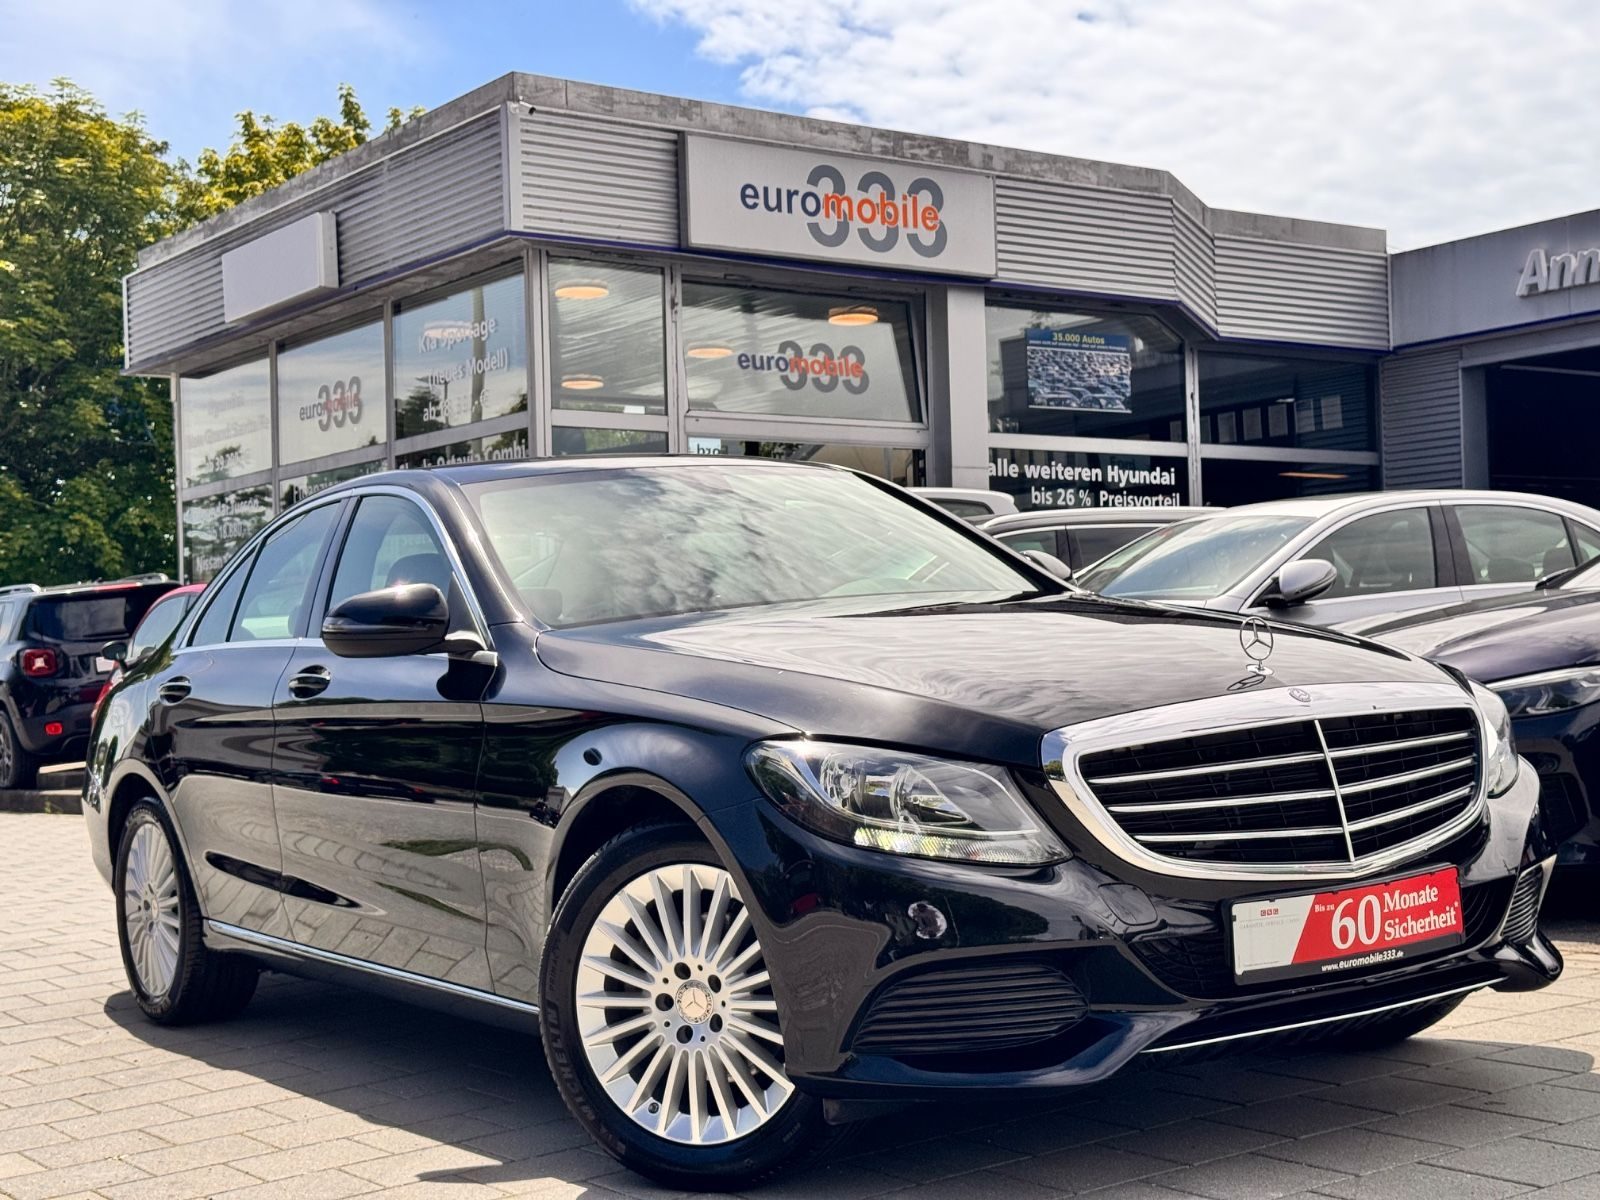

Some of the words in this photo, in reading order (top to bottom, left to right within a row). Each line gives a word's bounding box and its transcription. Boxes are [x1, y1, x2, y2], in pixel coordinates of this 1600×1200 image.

[740, 183, 939, 231] euromobile
[807, 165, 948, 258] 333
[1515, 248, 1600, 296] Ann
[1082, 335, 1104, 345] Autos
[466, 348, 509, 375] Modell)
[738, 352, 864, 377] euromobile
[778, 340, 870, 395] 333
[318, 376, 362, 432] 333
[423, 402, 436, 421] ab
[988, 458, 1019, 478] alle
[1024, 461, 1102, 482] weiteren
[1107, 465, 1175, 487] Hyundai
[1031, 486, 1053, 505] bis
[1057, 488, 1075, 506] 26
[1079, 489, 1091, 506] %
[1100, 491, 1180, 507] Preisvorteil
[1314, 904, 1325, 912] Bis
[1326, 903, 1335, 911] zu
[1383, 885, 1438, 913] Monate
[1331, 894, 1381, 949] 60
[1321, 950, 1404, 971] www.euromobile333.de
